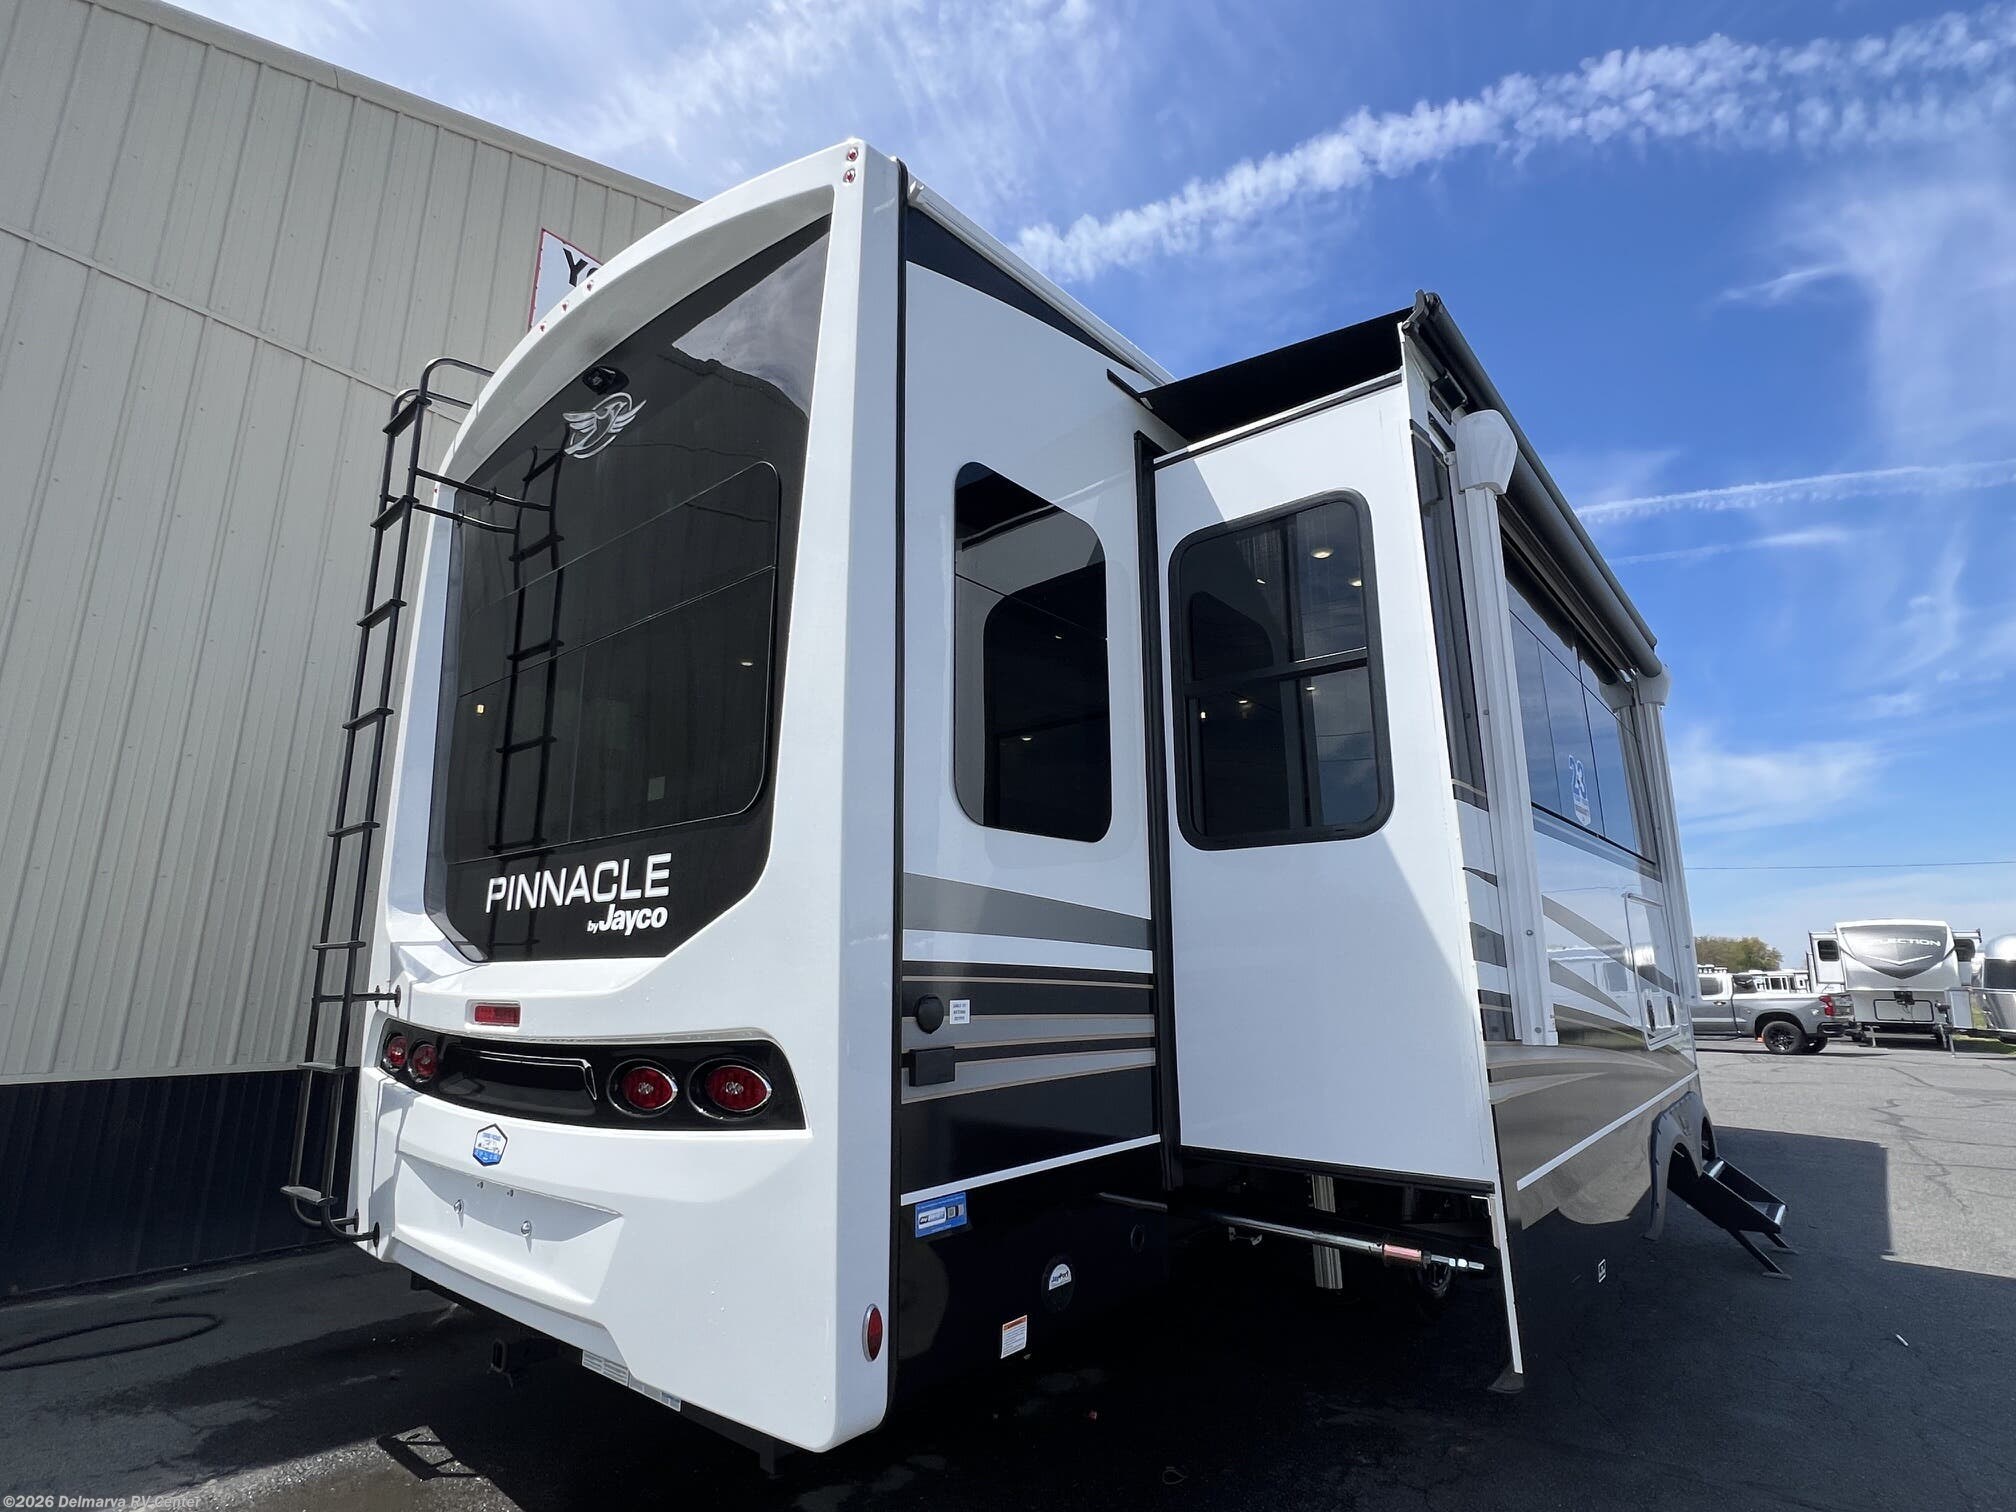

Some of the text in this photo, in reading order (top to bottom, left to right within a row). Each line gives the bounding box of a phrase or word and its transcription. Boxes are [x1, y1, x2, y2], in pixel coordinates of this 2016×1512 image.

[485, 852, 672, 914] PINNACLE
[586, 903, 669, 936] by Jayco
[1856, 936, 1942, 948] LECTION
